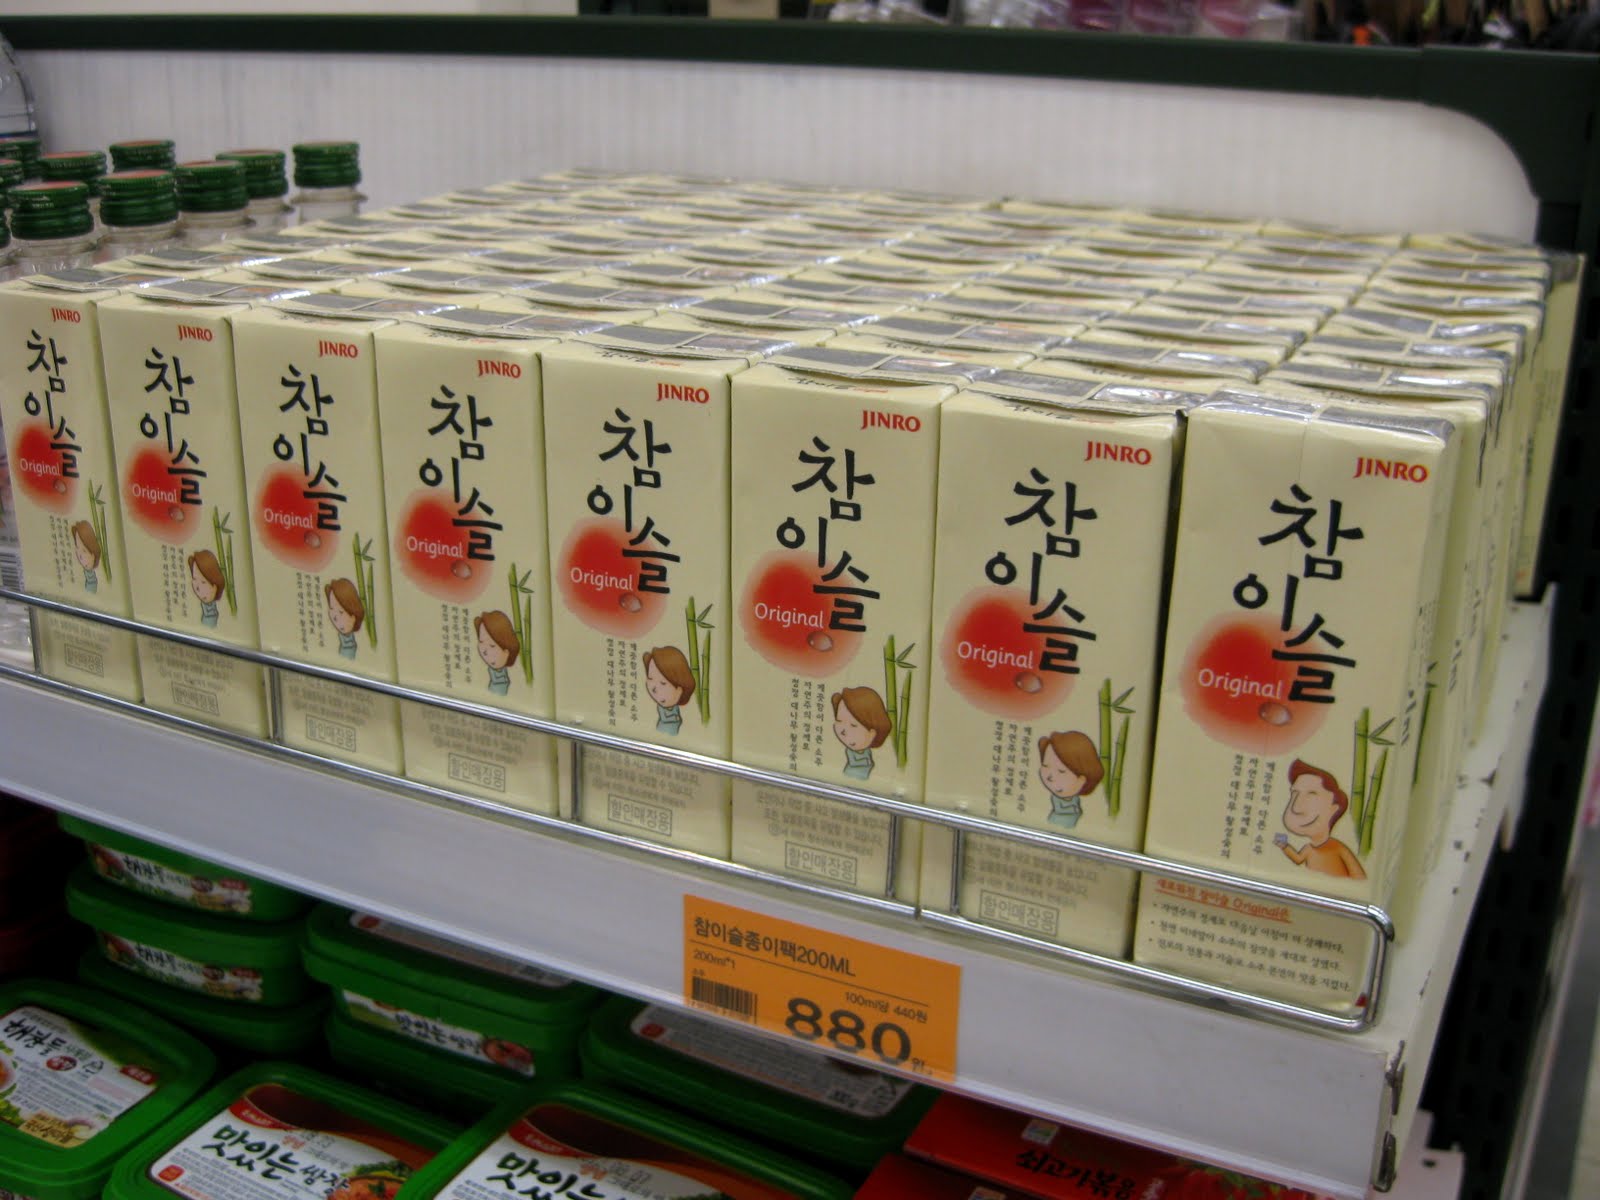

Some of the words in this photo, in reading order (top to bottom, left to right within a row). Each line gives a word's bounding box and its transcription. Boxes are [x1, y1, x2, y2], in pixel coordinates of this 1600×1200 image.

[51, 308, 80, 323] JINRO
[178, 326, 213, 342] JINRO
[319, 341, 359, 358] JINRO
[478, 360, 522, 379] JINRO
[24, 329, 82, 478] 참이슬
[657, 383, 711, 404] JINRO
[139, 347, 207, 505] 참이슬
[861, 410, 923, 433] JINRO
[272, 364, 347, 531] 참이슬
[1085, 441, 1153, 466] JINRO
[20, 458, 60, 481] Original
[419, 385, 503, 562] 참이슬
[1353, 457, 1429, 484] JINRO
[132, 483, 177, 506] Original
[586, 407, 681, 594] 참이슬
[264, 509, 313, 532] Original
[776, 436, 881, 633] 참이슬
[406, 536, 463, 561] Original
[570, 567, 633, 592] Original
[984, 467, 1098, 675] 참이슬
[1233, 483, 1365, 704] 참이슬
[755, 602, 823, 633] Original
[957, 640, 1033, 673] Original
[1199, 668, 1282, 706] Original
[694, 916, 856, 977] 참이슬종이팩200ML
[785, 997, 912, 1066] 880
[202, 1125, 299, 1180] 맛있는
